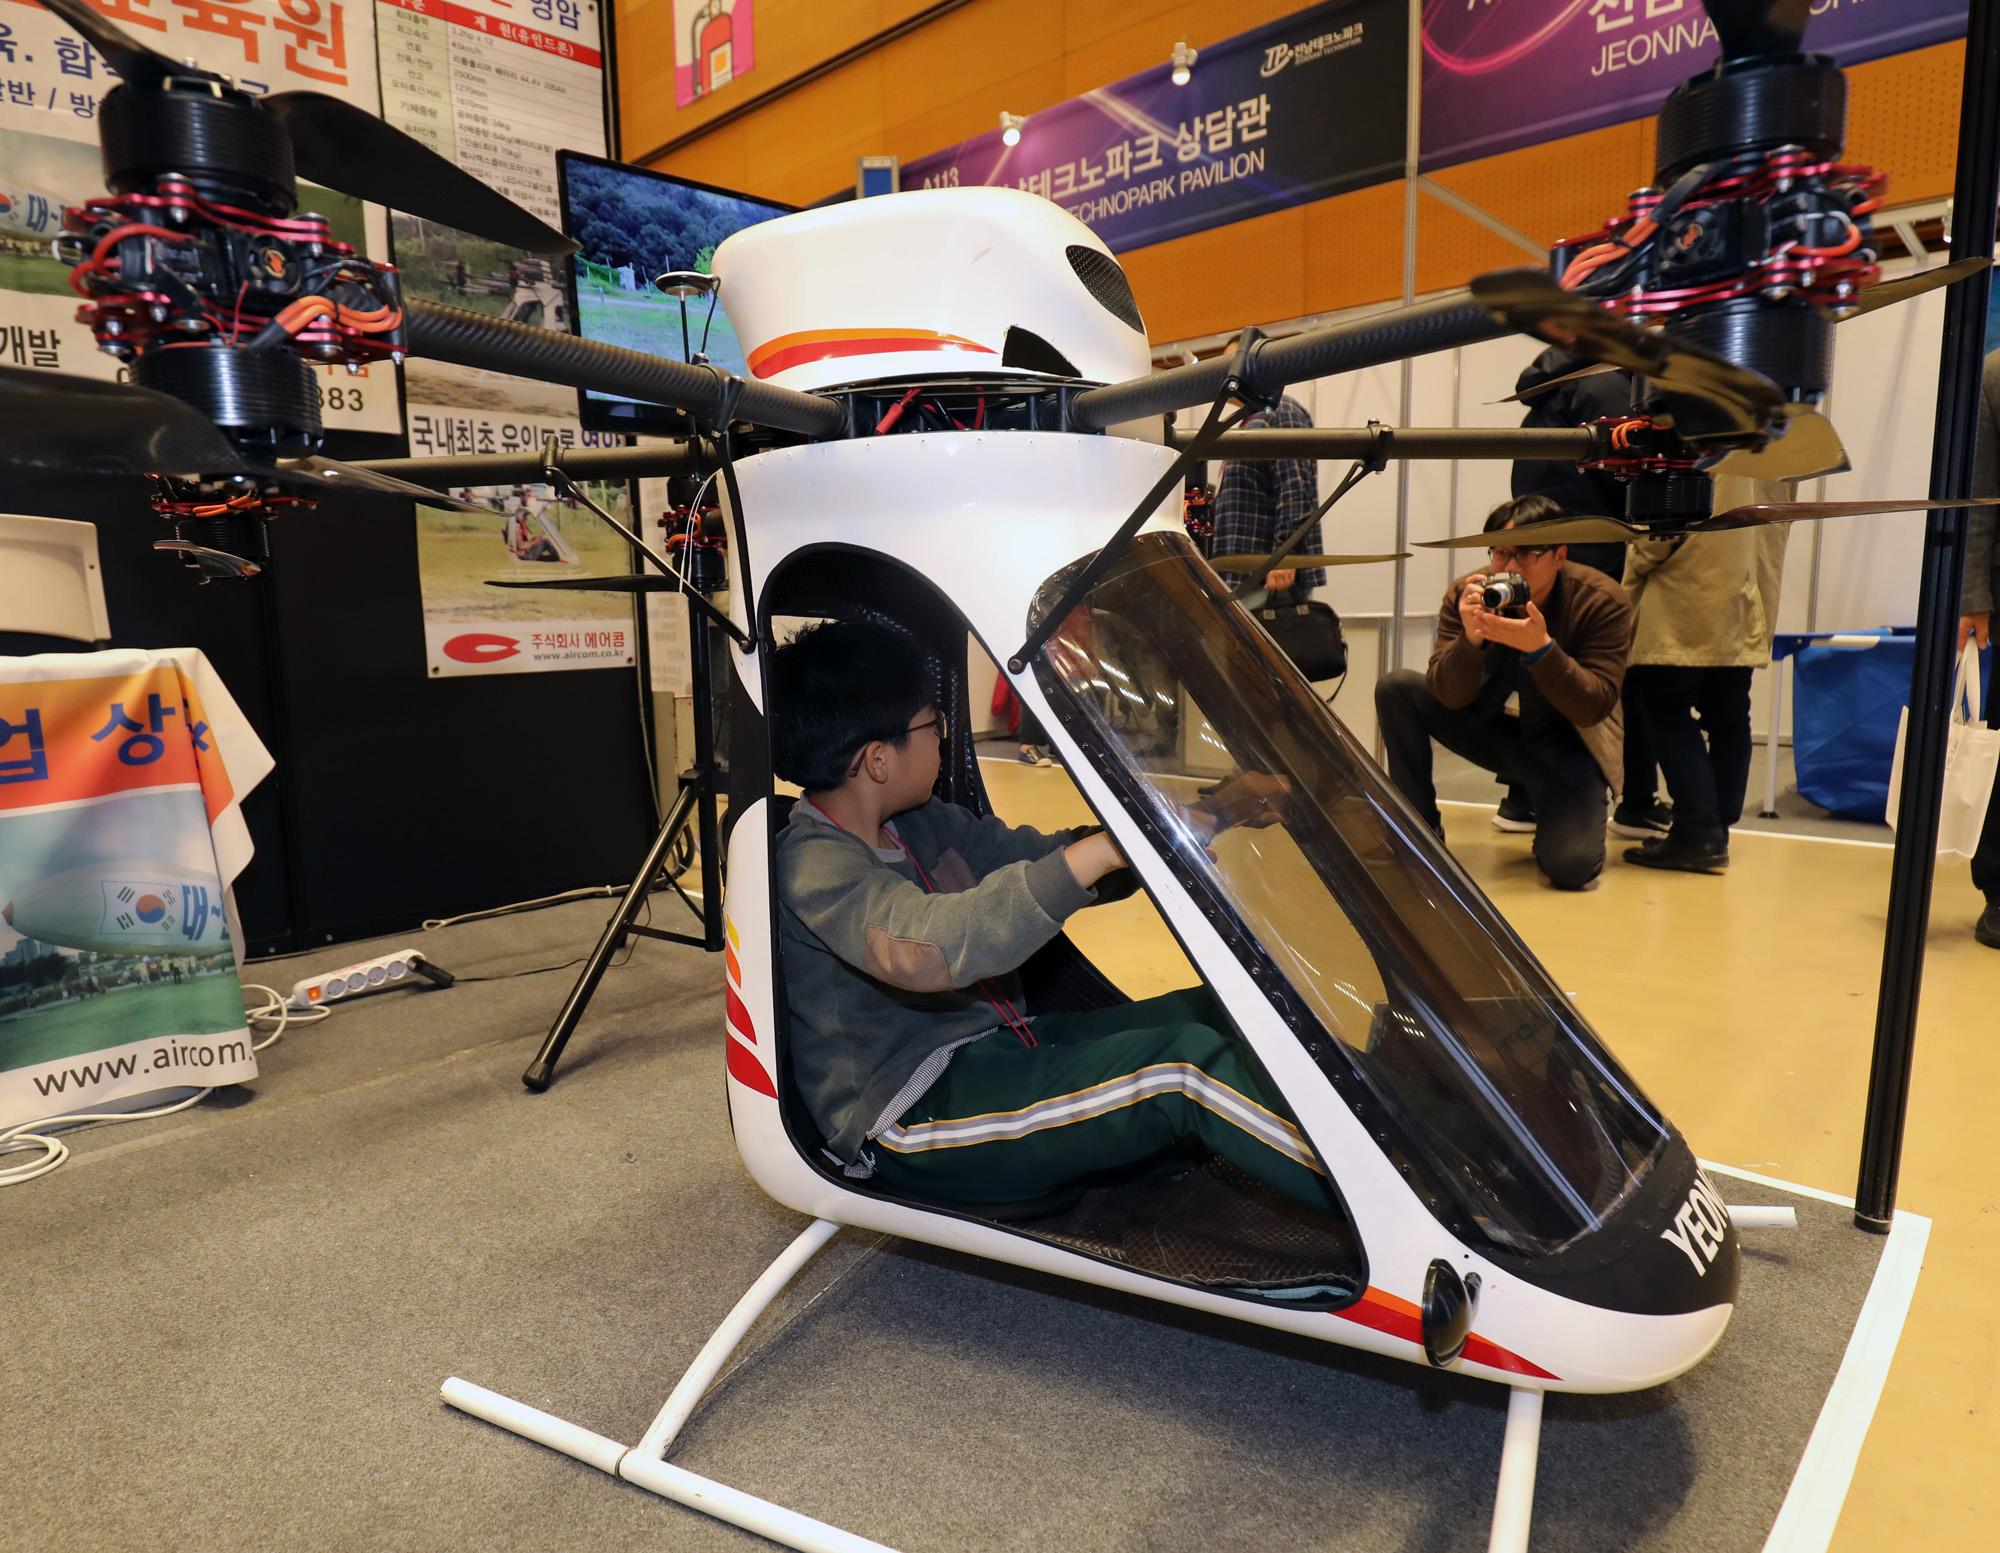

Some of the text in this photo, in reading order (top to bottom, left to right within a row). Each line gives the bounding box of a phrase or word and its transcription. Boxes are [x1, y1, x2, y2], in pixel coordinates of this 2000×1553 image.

[1591, 16, 1720, 77] JEONNA
[0, 78, 36, 107] 반
[1000, 93, 1271, 201] 테크노파크 상담관
[1066, 147, 1265, 224] ECHNOPARK PAVILION
[412, 415, 496, 456] 국내최초
[532, 631, 625, 649] 주식회사 에어콤
[533, 649, 624, 660] www.aircom.co.kr
[33, 1038, 253, 1097] www.aircom.
[1660, 1163, 1729, 1277] YEON
